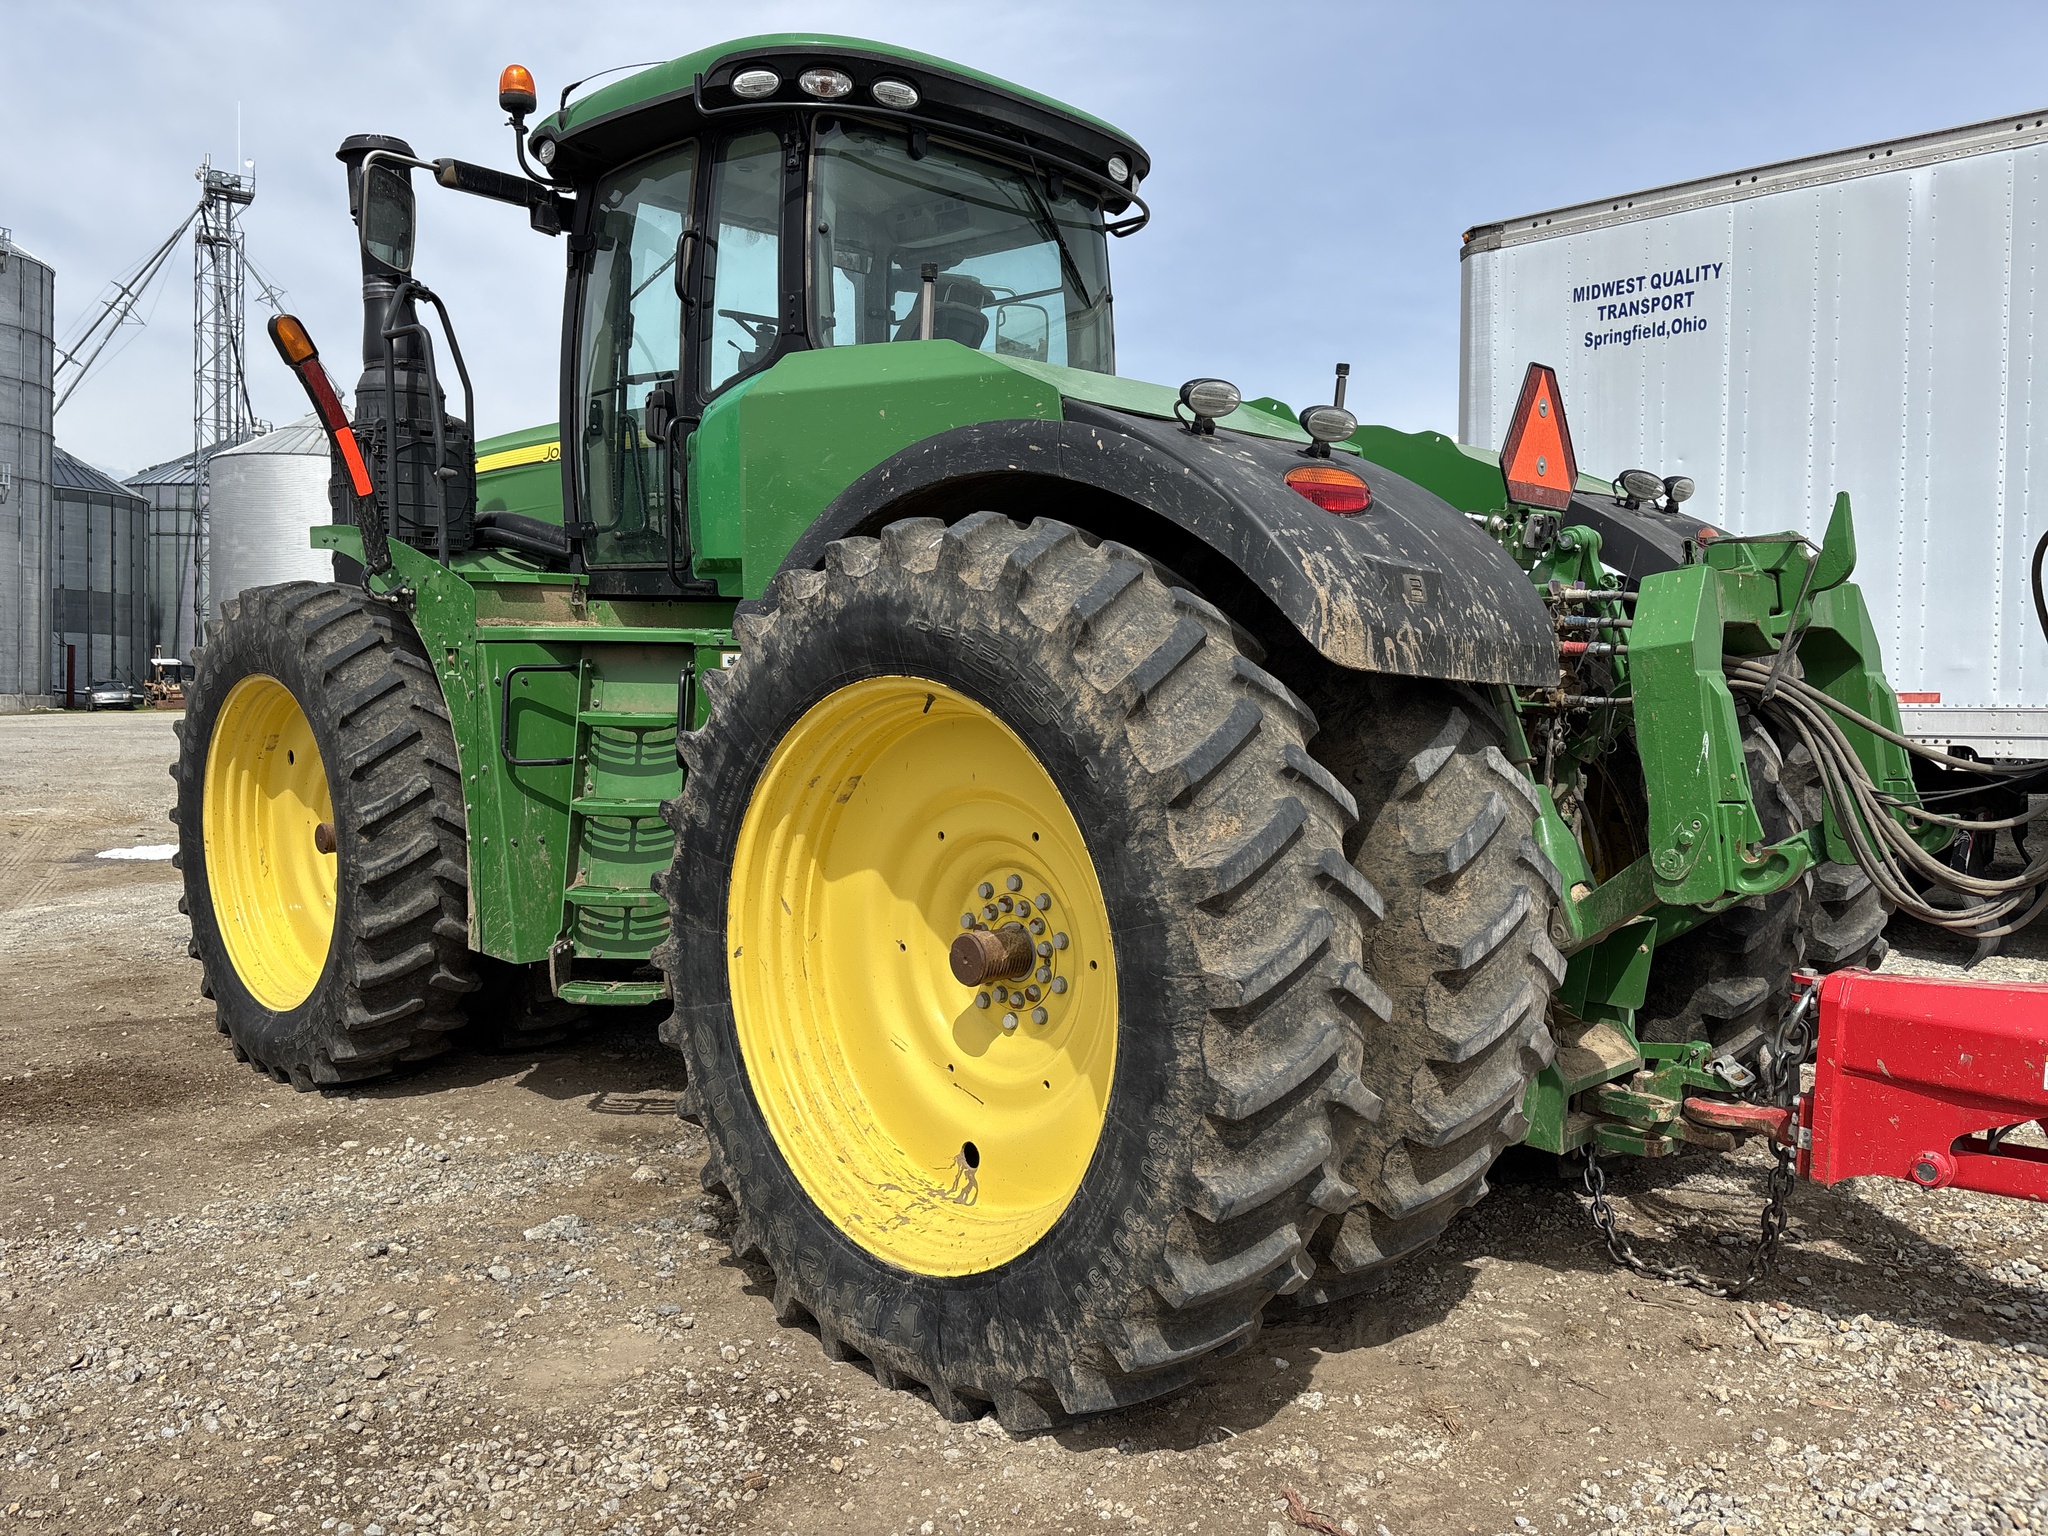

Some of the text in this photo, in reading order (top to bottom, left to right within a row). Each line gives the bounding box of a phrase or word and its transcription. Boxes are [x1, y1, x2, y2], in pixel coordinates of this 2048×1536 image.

[1573, 262, 1723, 303] MIDWEST QUALITY
[1597, 291, 1695, 321] TRANSPORT
[543, 446, 560, 459] JO
